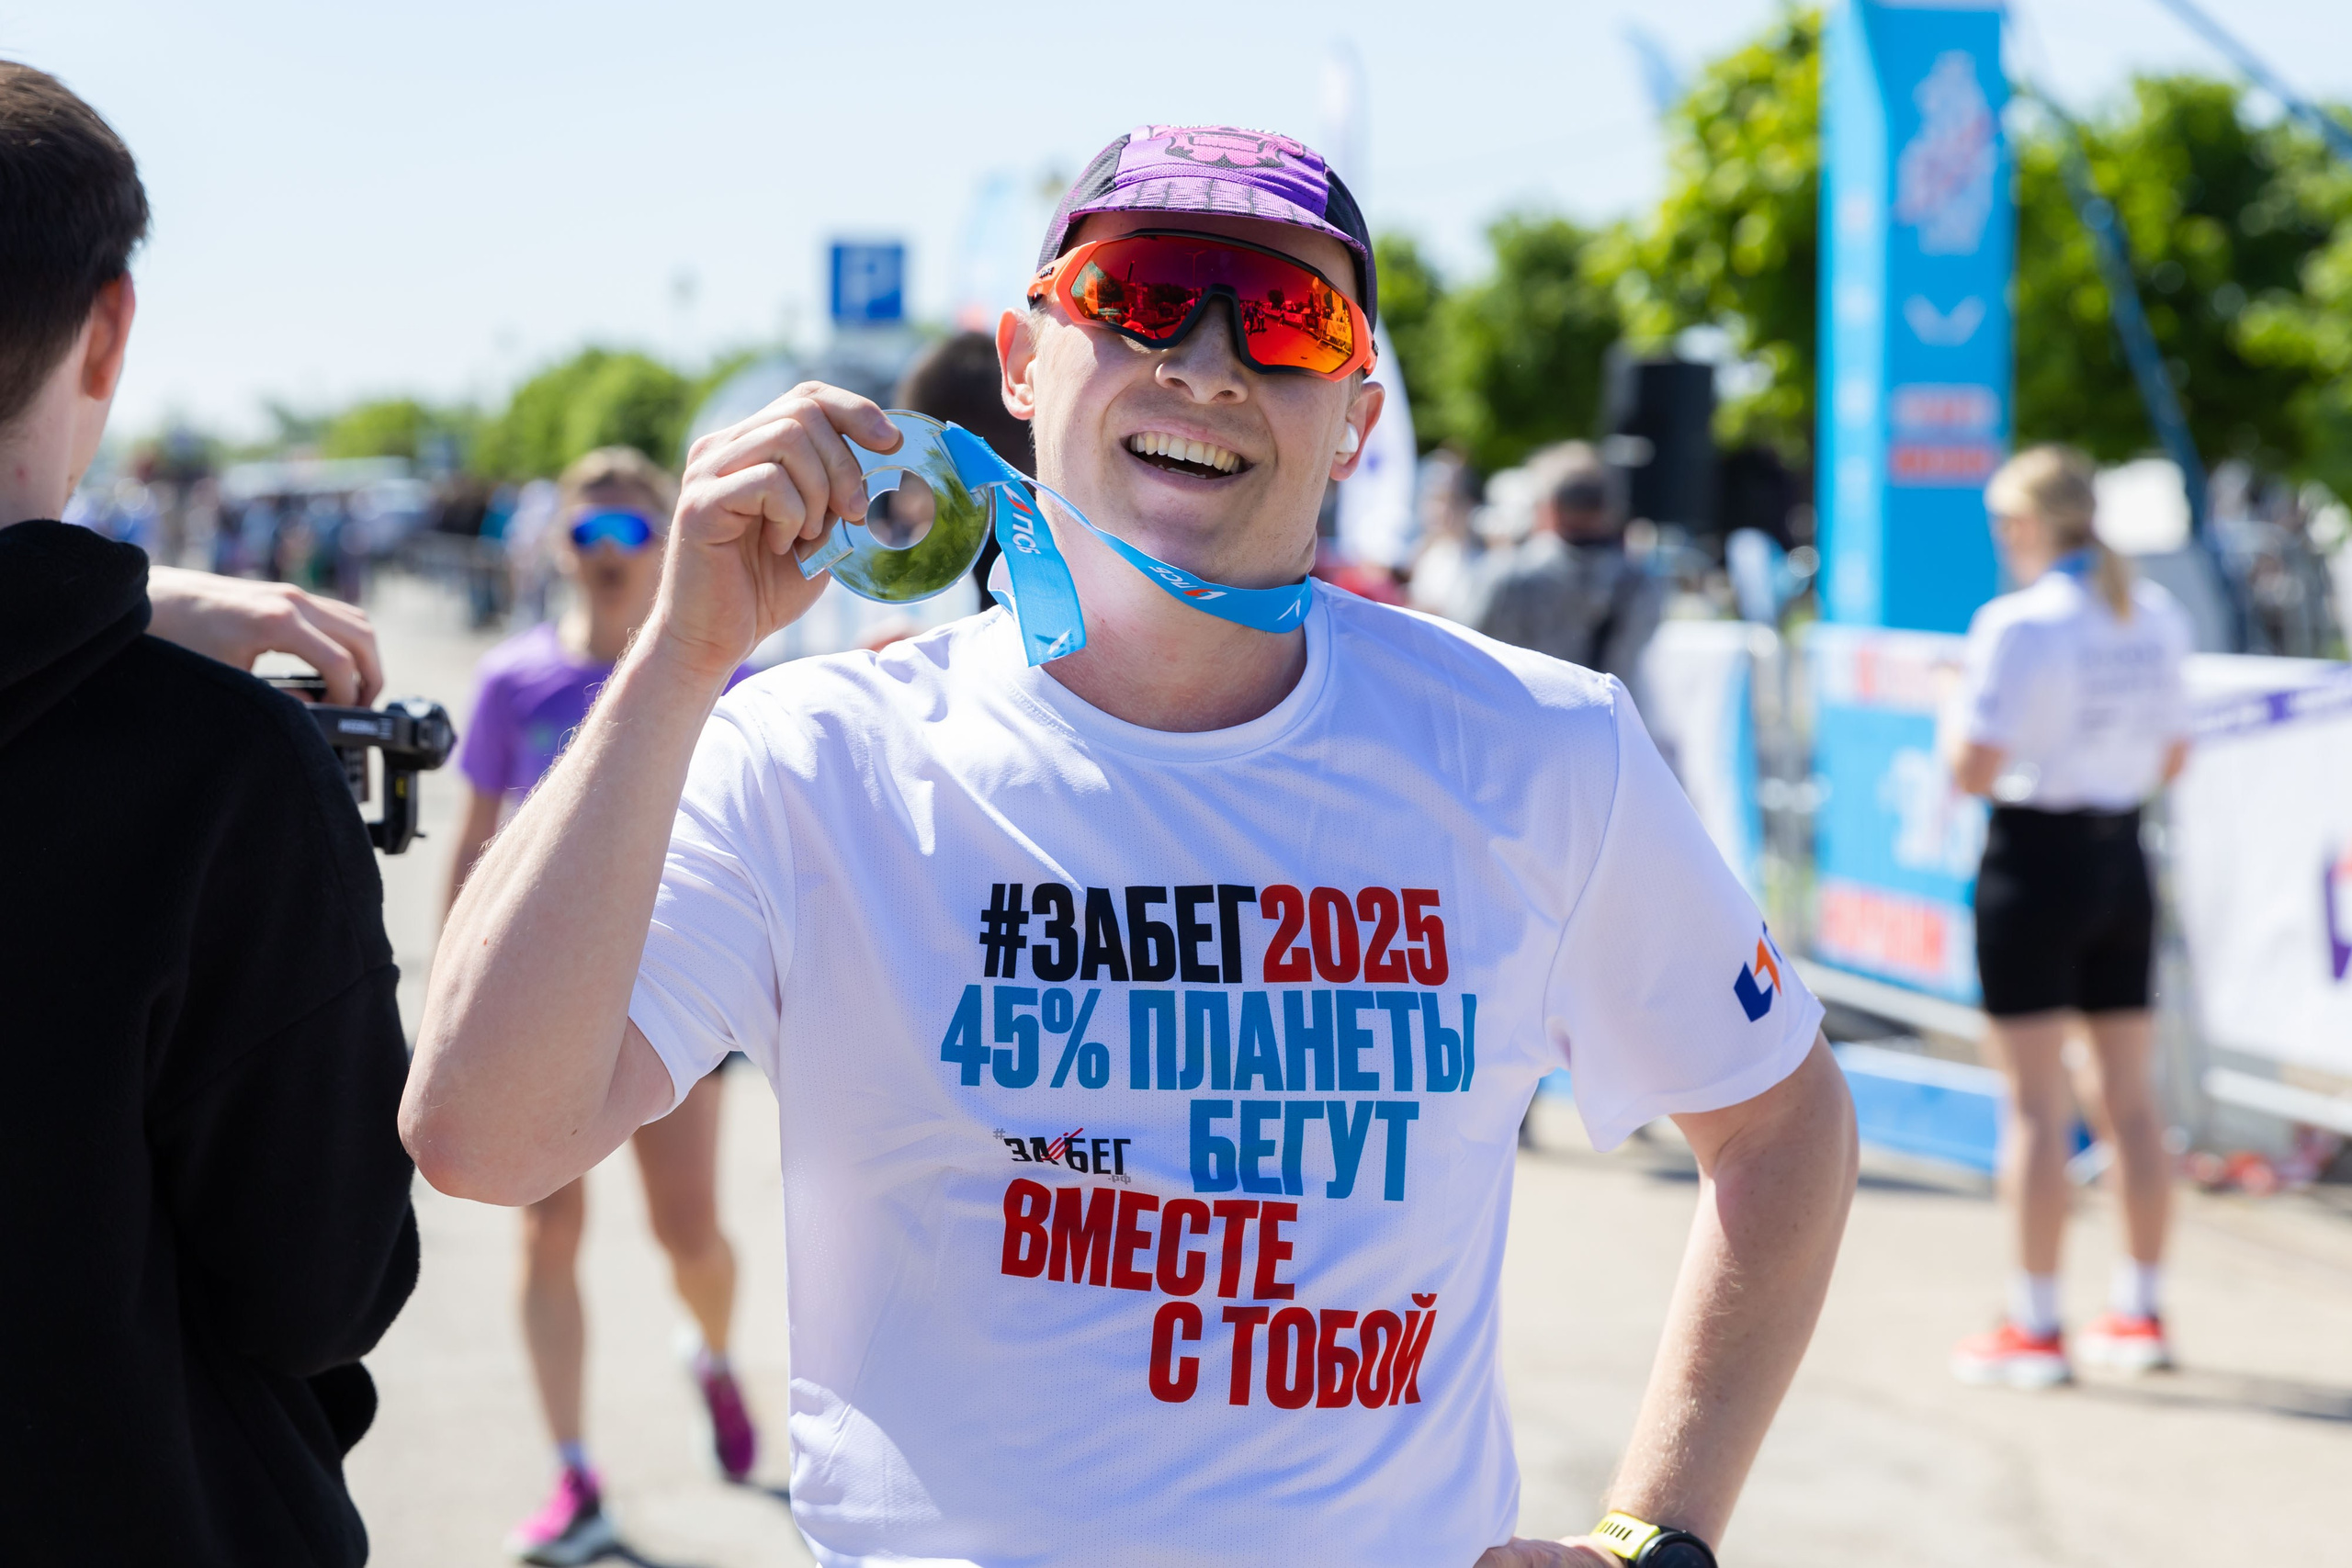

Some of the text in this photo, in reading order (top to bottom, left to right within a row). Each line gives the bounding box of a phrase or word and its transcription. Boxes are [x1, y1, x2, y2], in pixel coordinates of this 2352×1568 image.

[941, 985, 1476, 1092] 45% ПЛАНЕТЫ
[1190, 1100, 1419, 1201] БЕГУТ
[1001, 1179, 1298, 1300] ВМЕСТЕ
[1149, 1293, 1437, 1409] С ТОБОЙ
